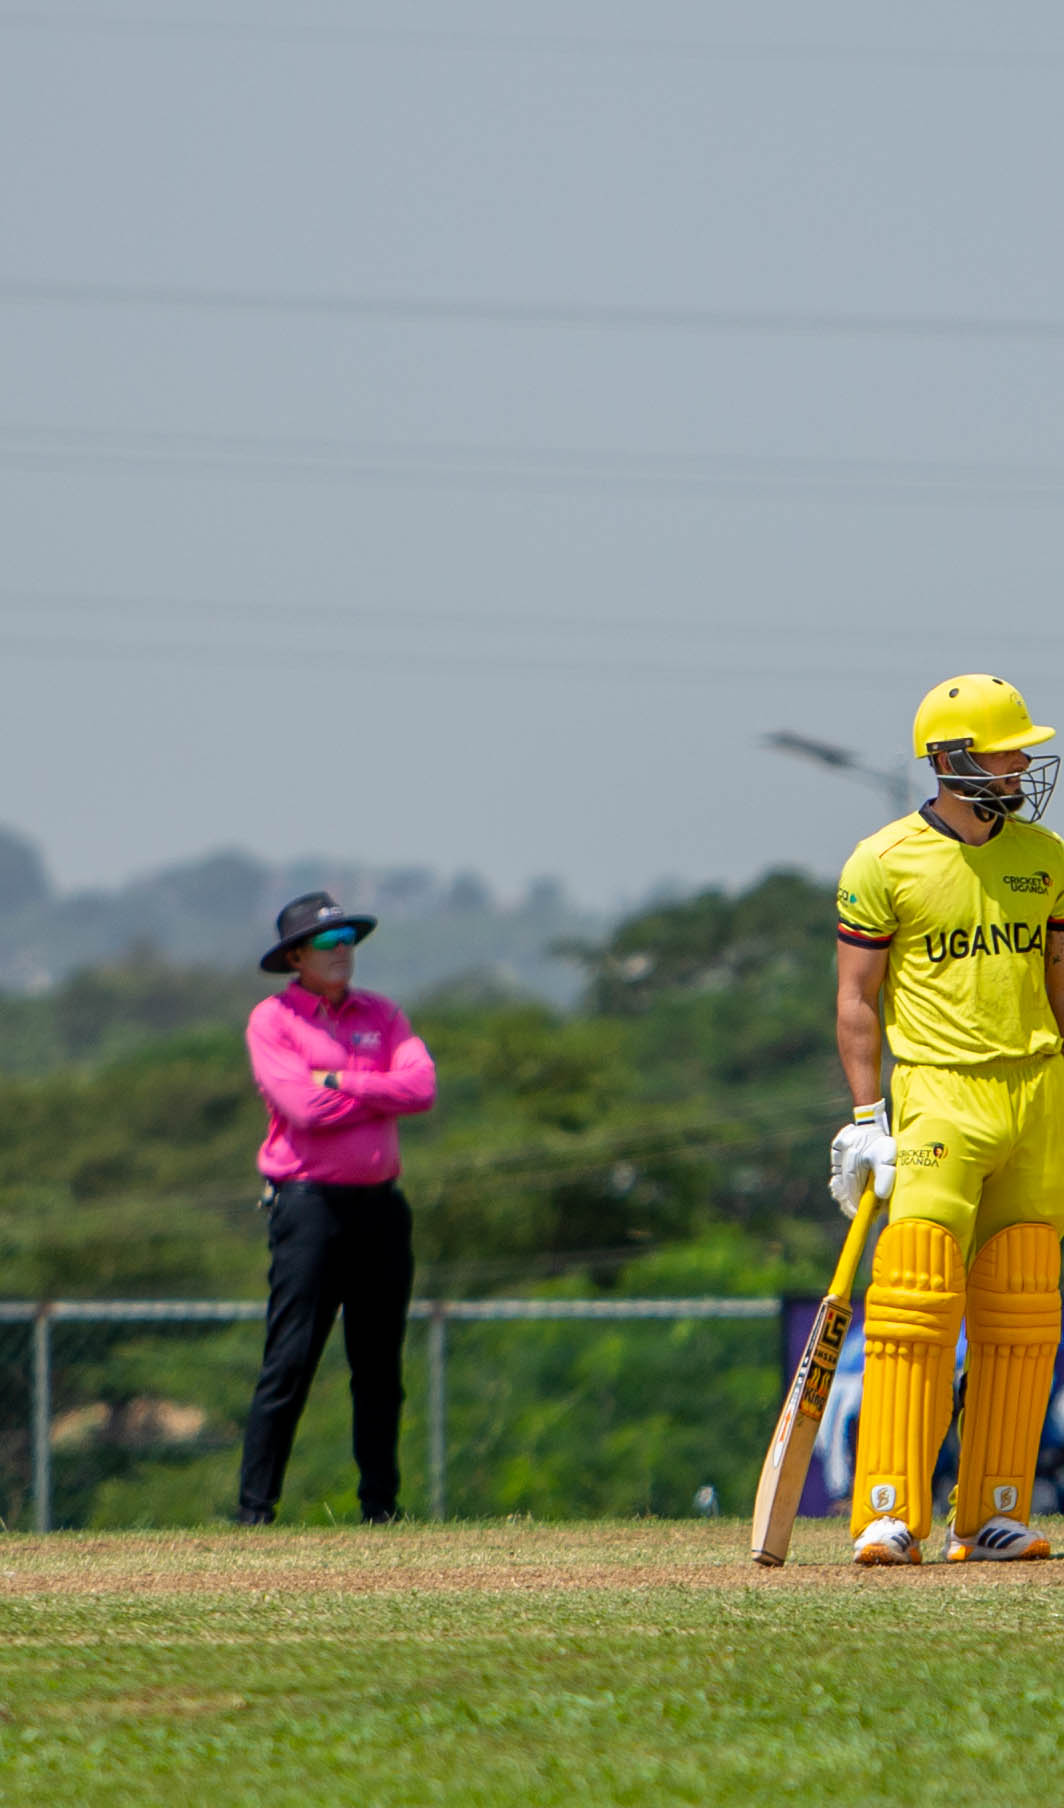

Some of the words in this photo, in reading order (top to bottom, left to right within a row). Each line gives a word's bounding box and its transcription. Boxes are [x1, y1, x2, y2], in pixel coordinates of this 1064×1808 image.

[1003, 875, 1042, 887] CRICKET
[1010, 883, 1049, 896] UGANDA
[924, 922, 1044, 963] UGANDA
